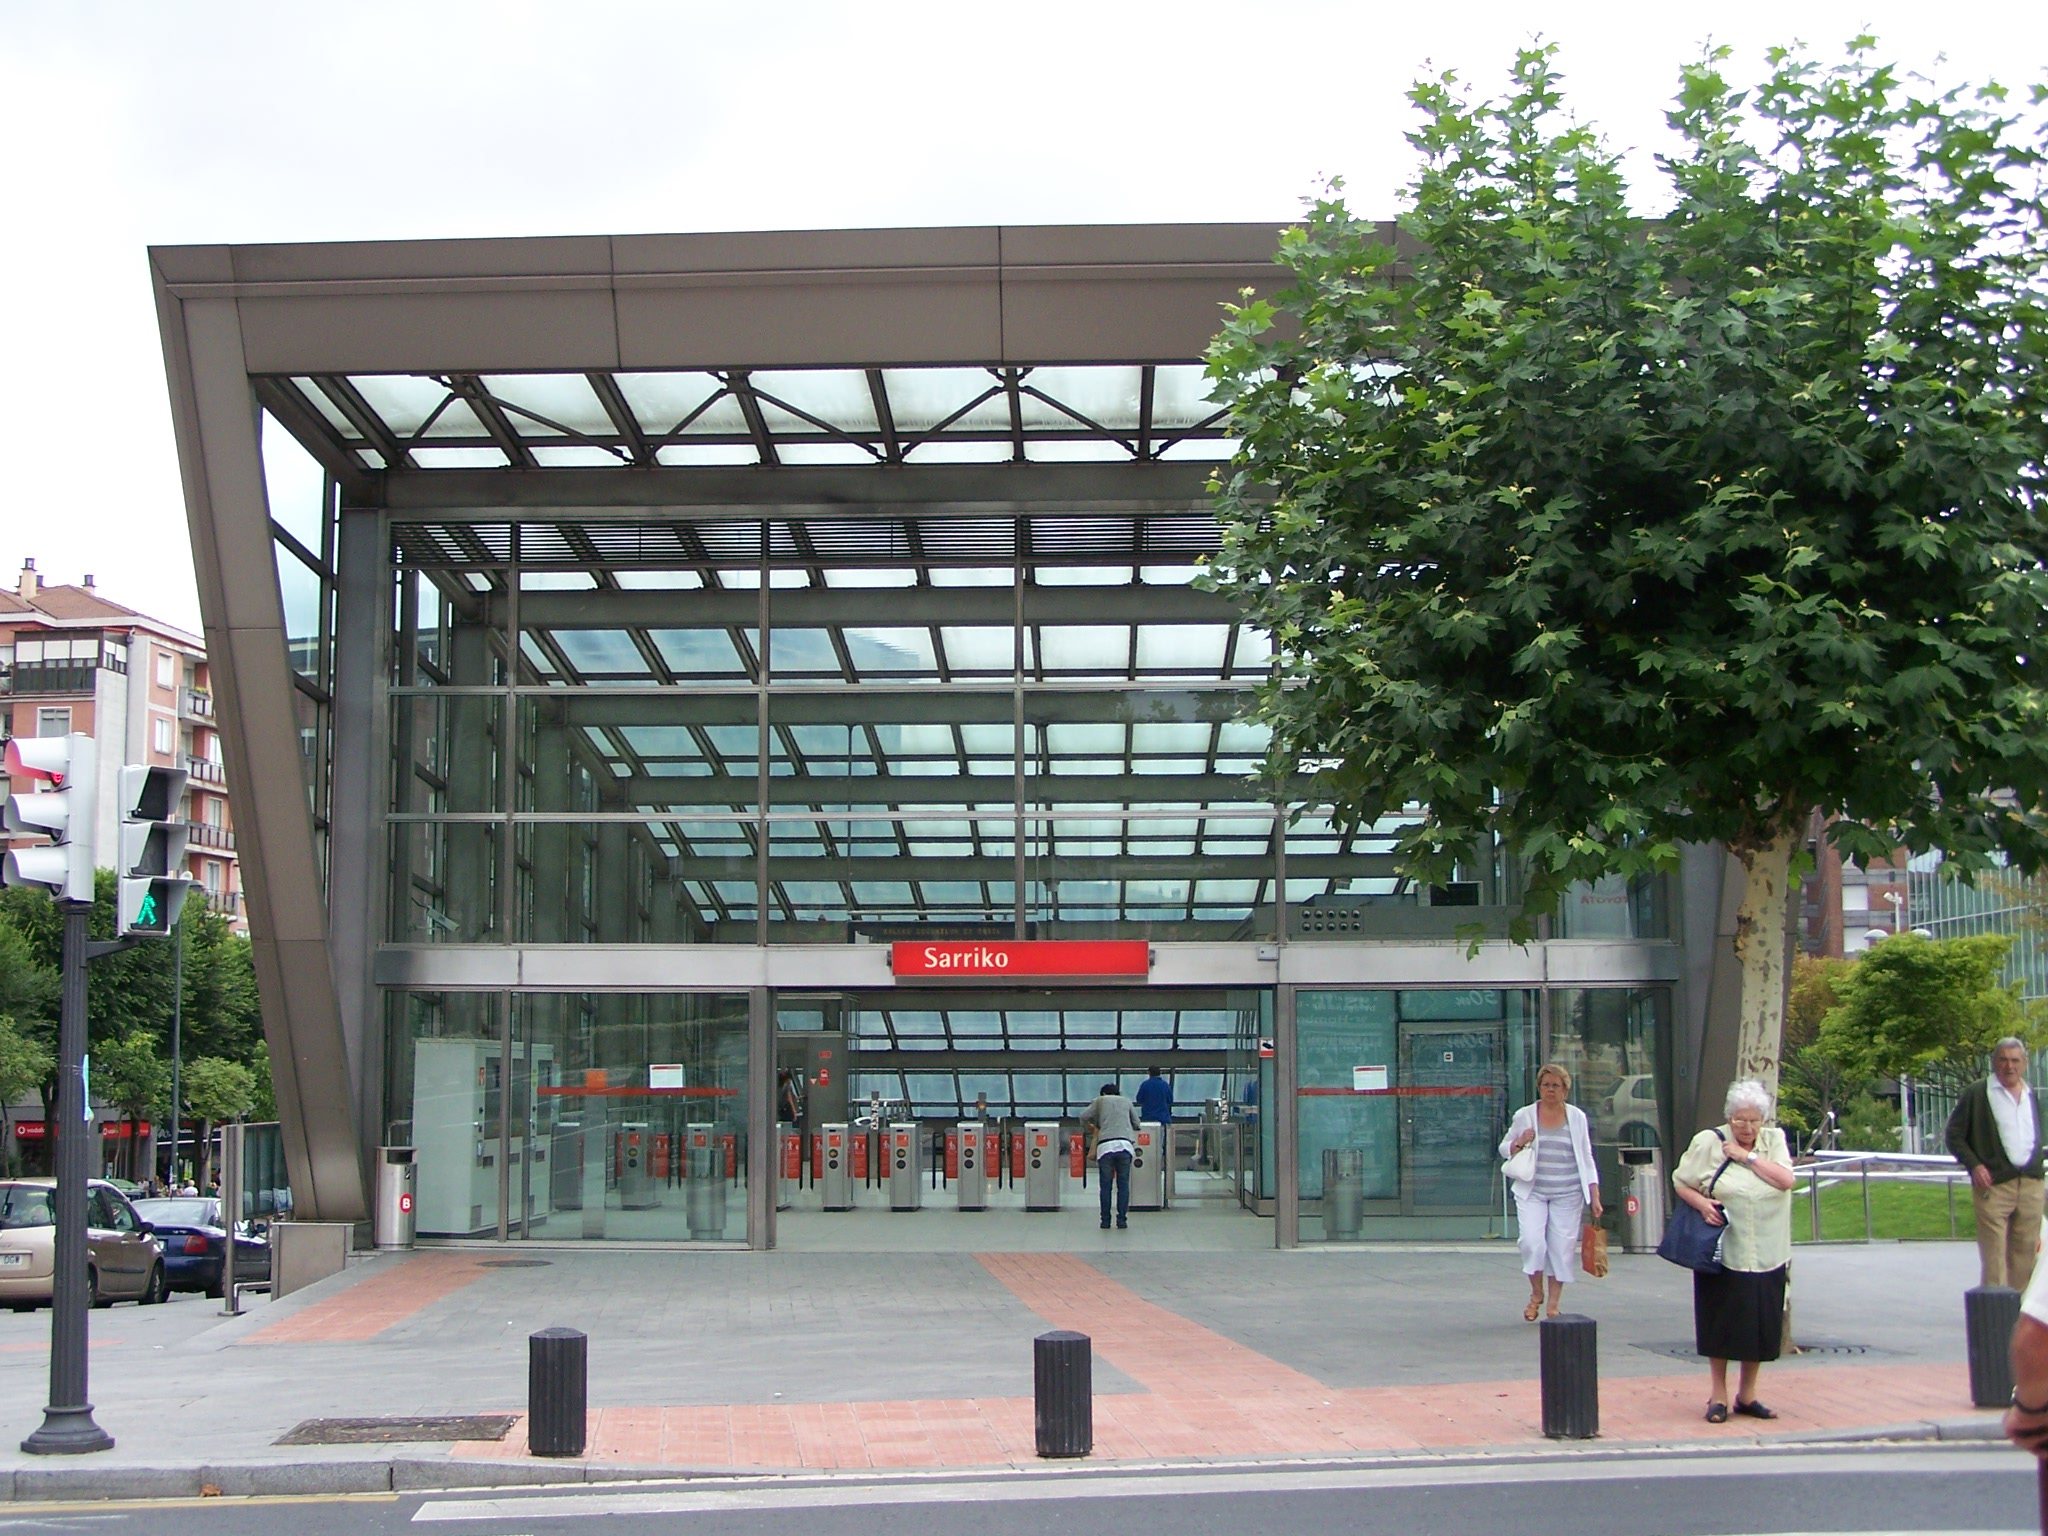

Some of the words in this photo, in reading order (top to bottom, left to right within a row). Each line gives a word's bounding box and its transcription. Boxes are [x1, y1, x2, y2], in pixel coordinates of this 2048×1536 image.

[924, 946, 1009, 968] Sarriko
[402, 1197, 411, 1210] B
[1627, 1200, 1637, 1212] B
